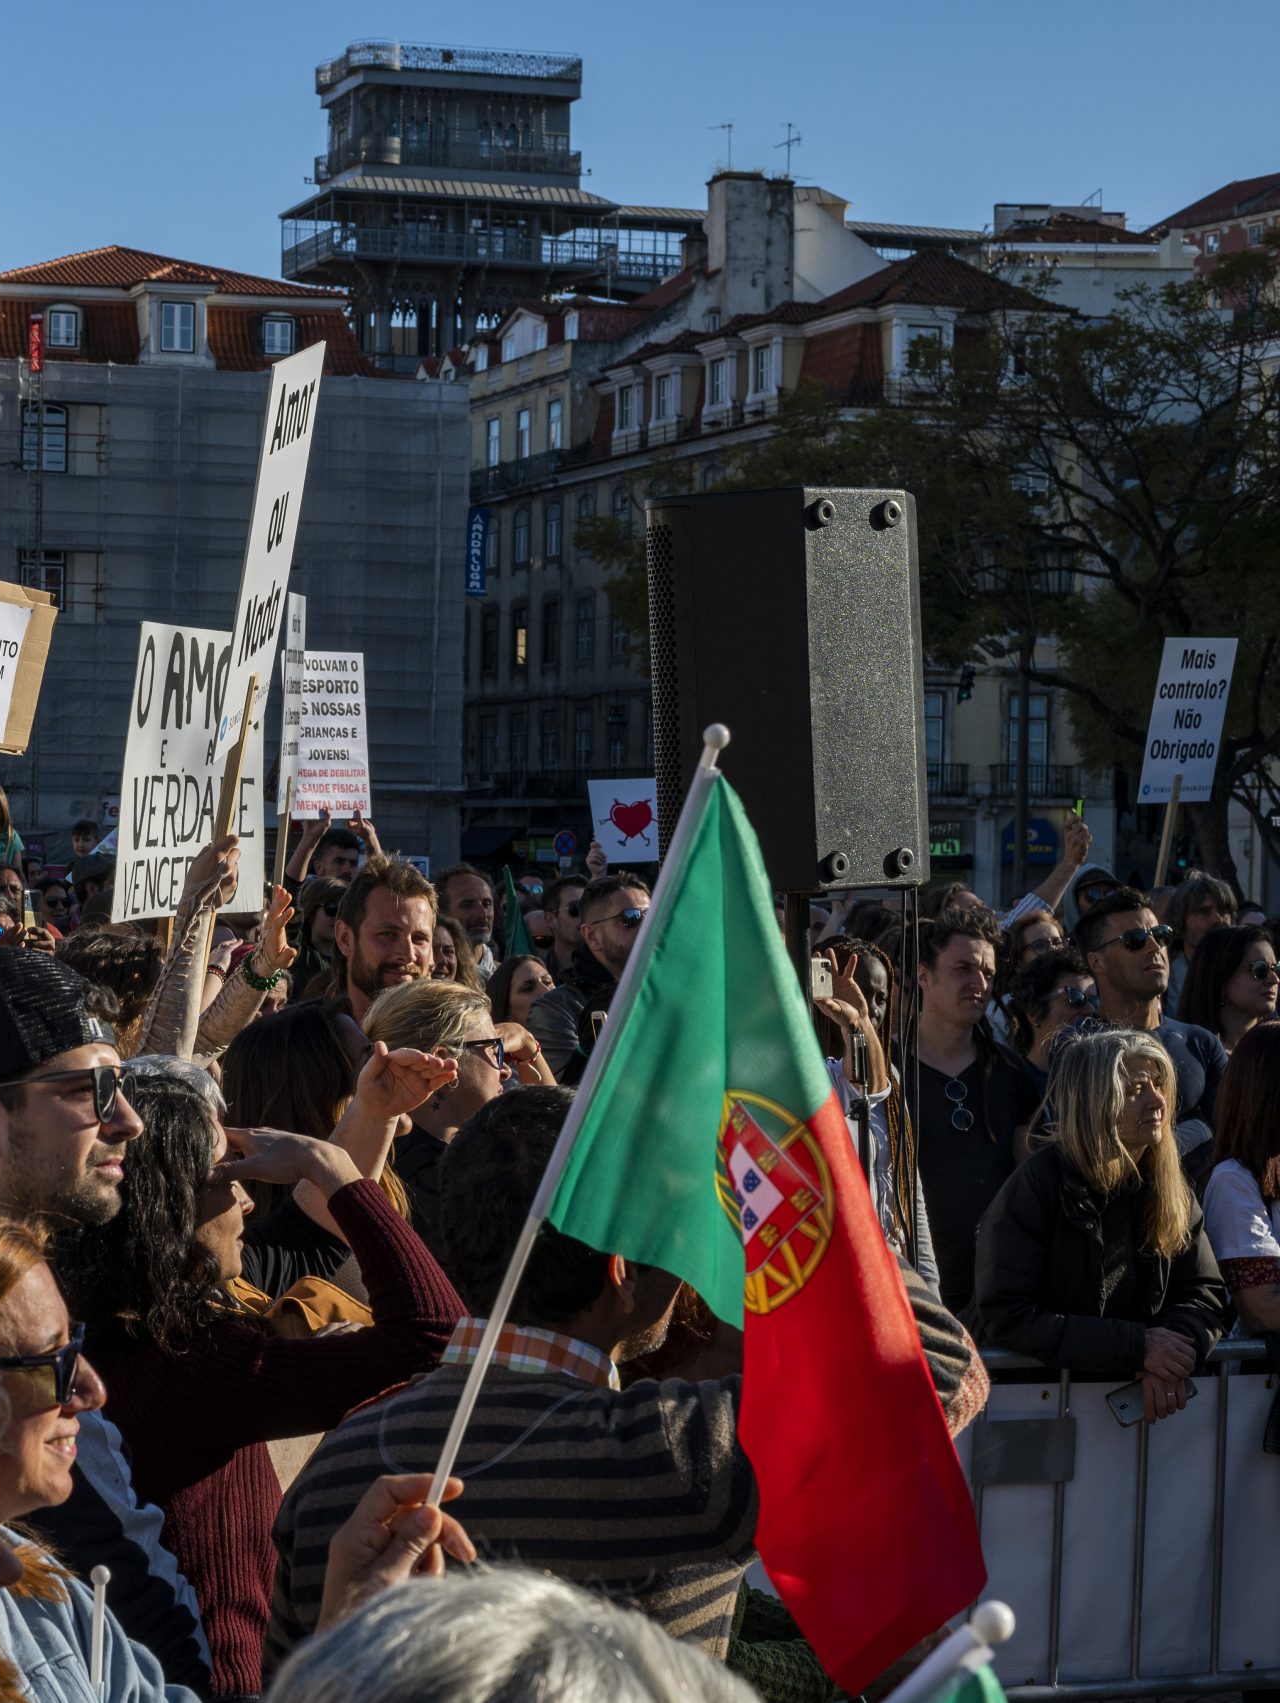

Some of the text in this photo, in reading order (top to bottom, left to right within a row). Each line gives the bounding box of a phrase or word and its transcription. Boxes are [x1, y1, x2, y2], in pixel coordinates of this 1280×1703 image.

[269, 378, 316, 455] Amor
[266, 491, 290, 554] ou
[237, 580, 282, 667] Nada
[304, 659, 359, 673] VOLVAM O
[1180, 649, 1216, 670] Mais
[137, 631, 233, 730] O AMO
[303, 679, 359, 694] ESPORTO
[1159, 679, 1227, 700] controlo?
[311, 702, 361, 716] NOSSAS
[1173, 708, 1202, 730] Não
[351, 728, 357, 738] E
[160, 738, 214, 768] E A
[308, 749, 350, 760] JOVENS!
[1150, 739, 1215, 763] Obrigado
[298, 769, 366, 777] HEGA DE DEBILITAR
[332, 781, 359, 793] FÍSICA
[361, 784, 367, 793] E
[133, 773, 255, 851] VERDAE
[296, 800, 367, 811] MENTAL DELAS!
[123, 856, 239, 918] VENCE
